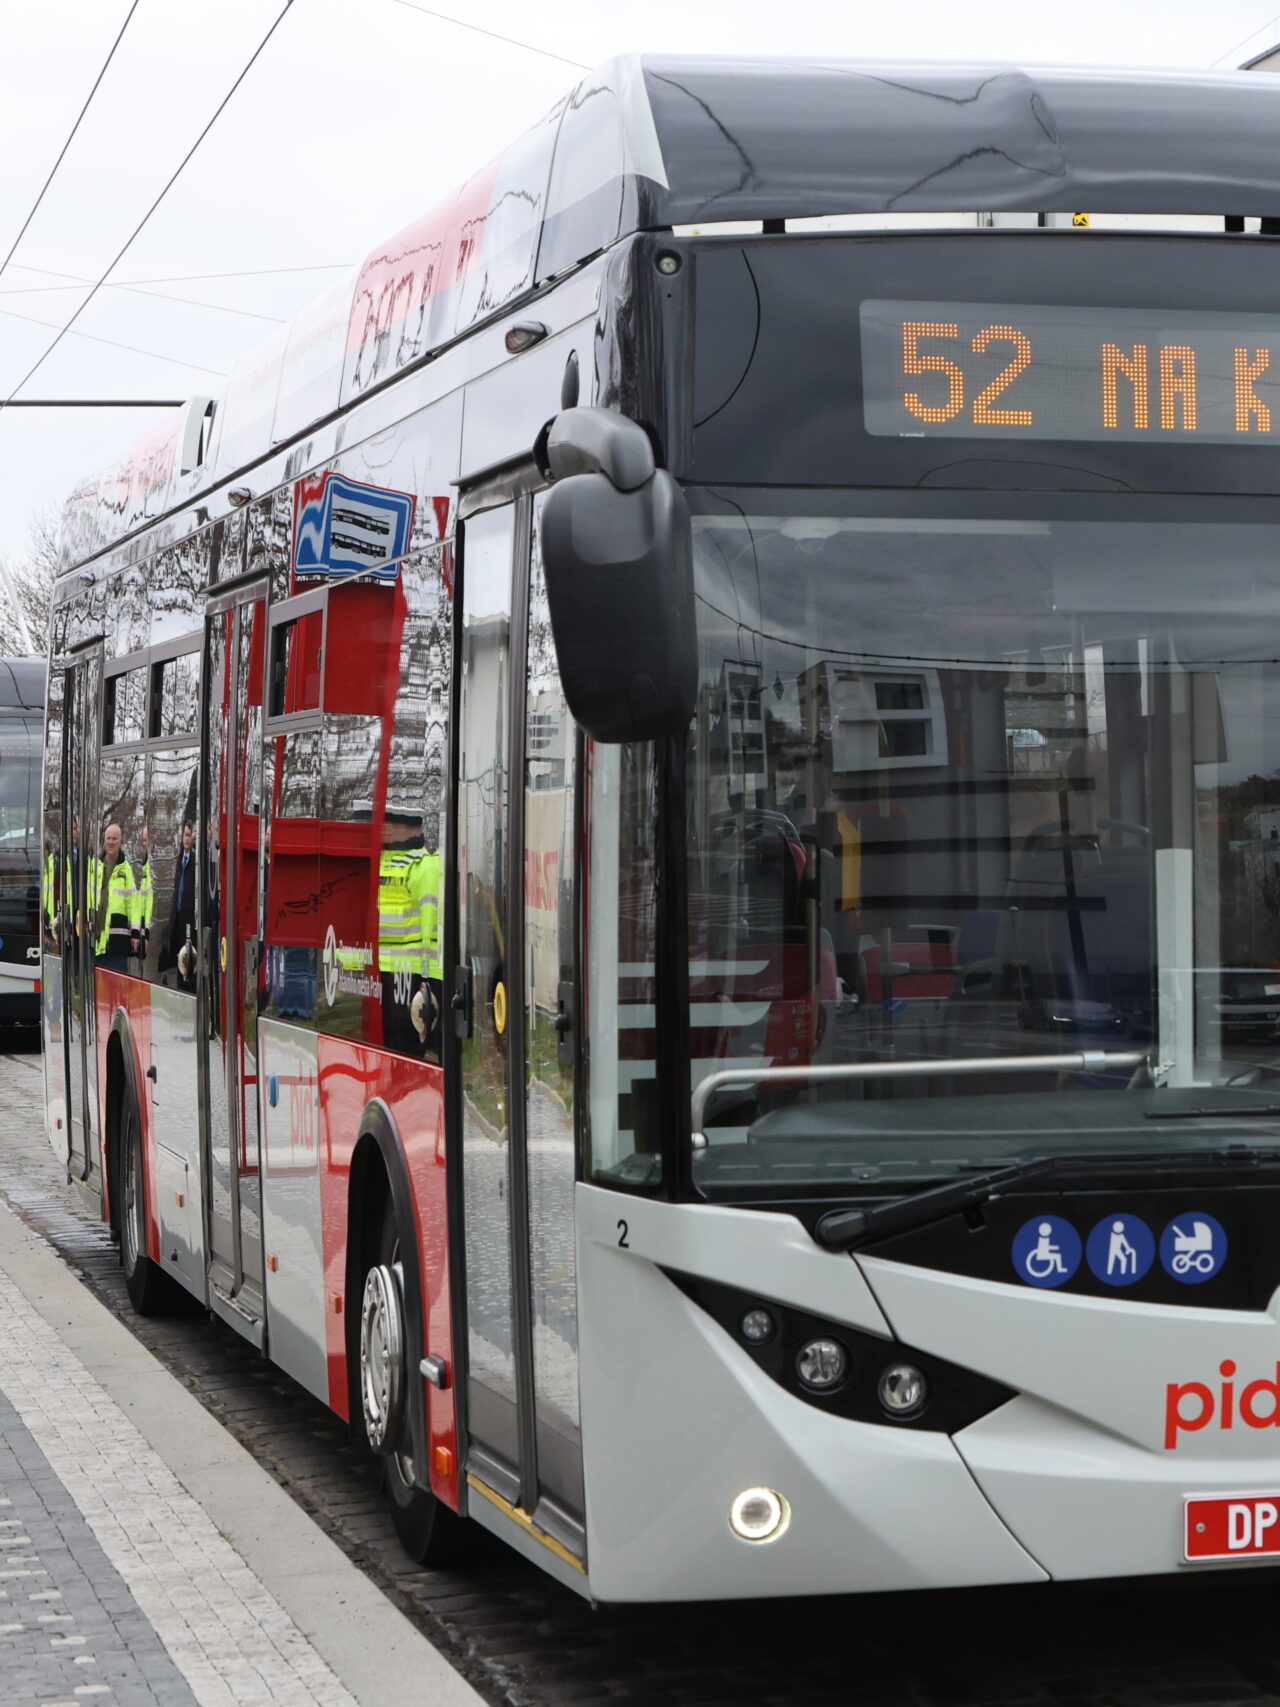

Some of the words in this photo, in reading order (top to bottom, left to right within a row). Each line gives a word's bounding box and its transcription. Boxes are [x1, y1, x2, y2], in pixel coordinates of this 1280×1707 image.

[902, 322, 1034, 426] 52
[1101, 342, 1199, 431] NA
[393, 958, 412, 1007] 509
[617, 1219, 630, 1249] 2
